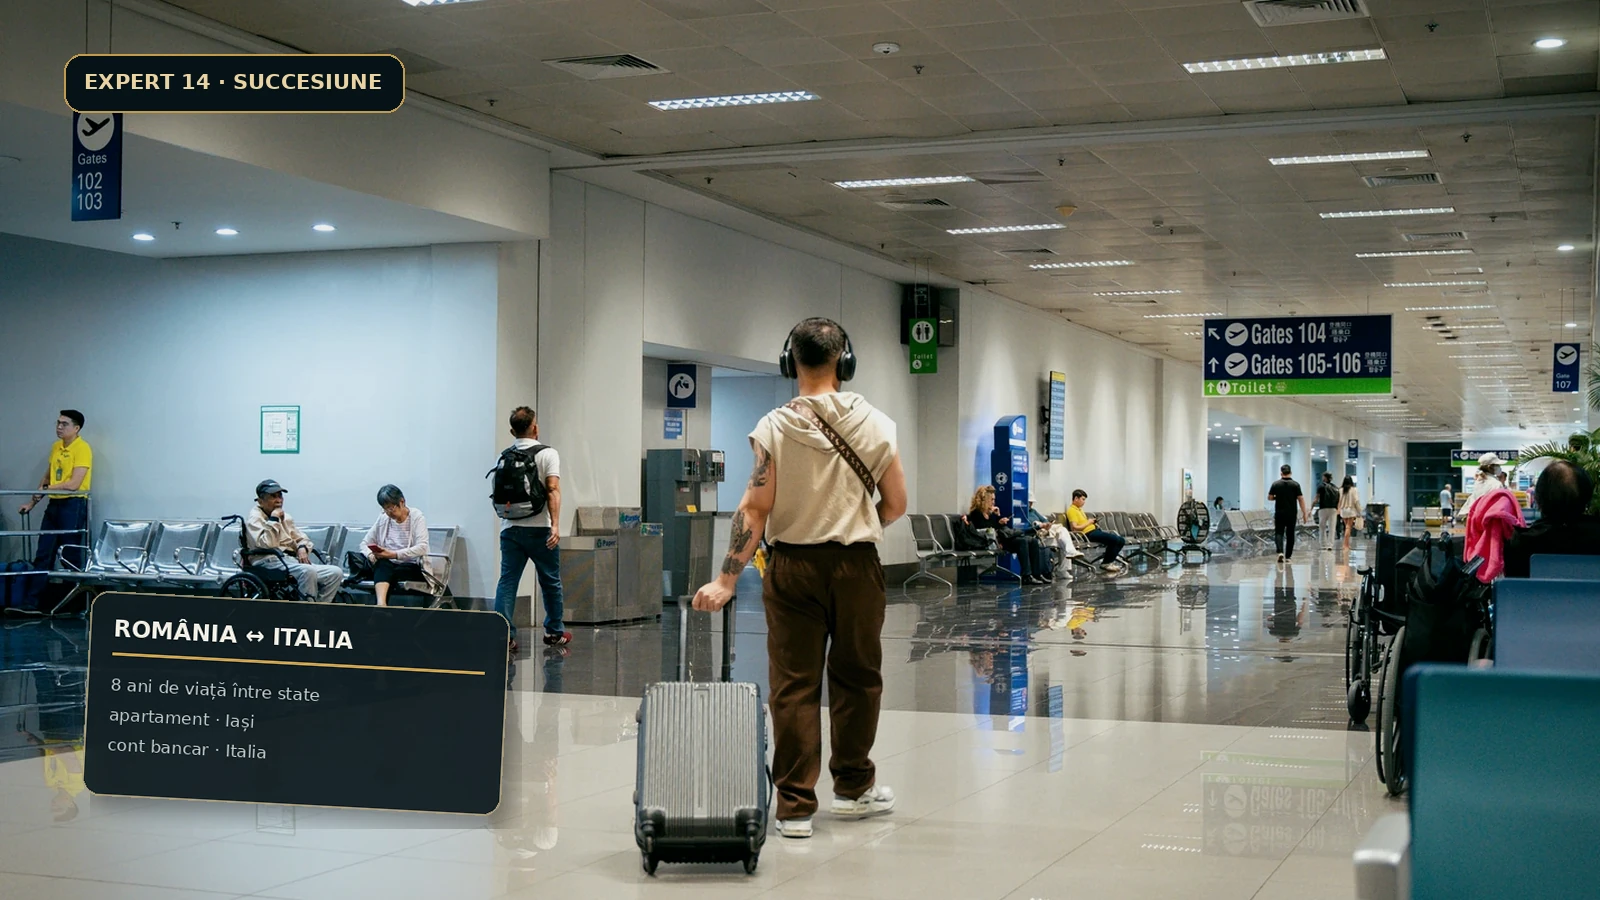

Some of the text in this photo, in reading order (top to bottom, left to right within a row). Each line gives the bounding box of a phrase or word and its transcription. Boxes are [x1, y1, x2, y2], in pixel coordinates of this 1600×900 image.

[77, 153, 107, 165] Gates
[77, 172, 103, 190] 102
[76, 192, 103, 211] 103
[1251, 322, 1327, 345] Gates 104
[1251, 351, 1361, 375] Gates 105-106
[1231, 381, 1273, 394] Toilet
[1556, 380, 1571, 389] 107
[602, 539, 616, 547] Paper
